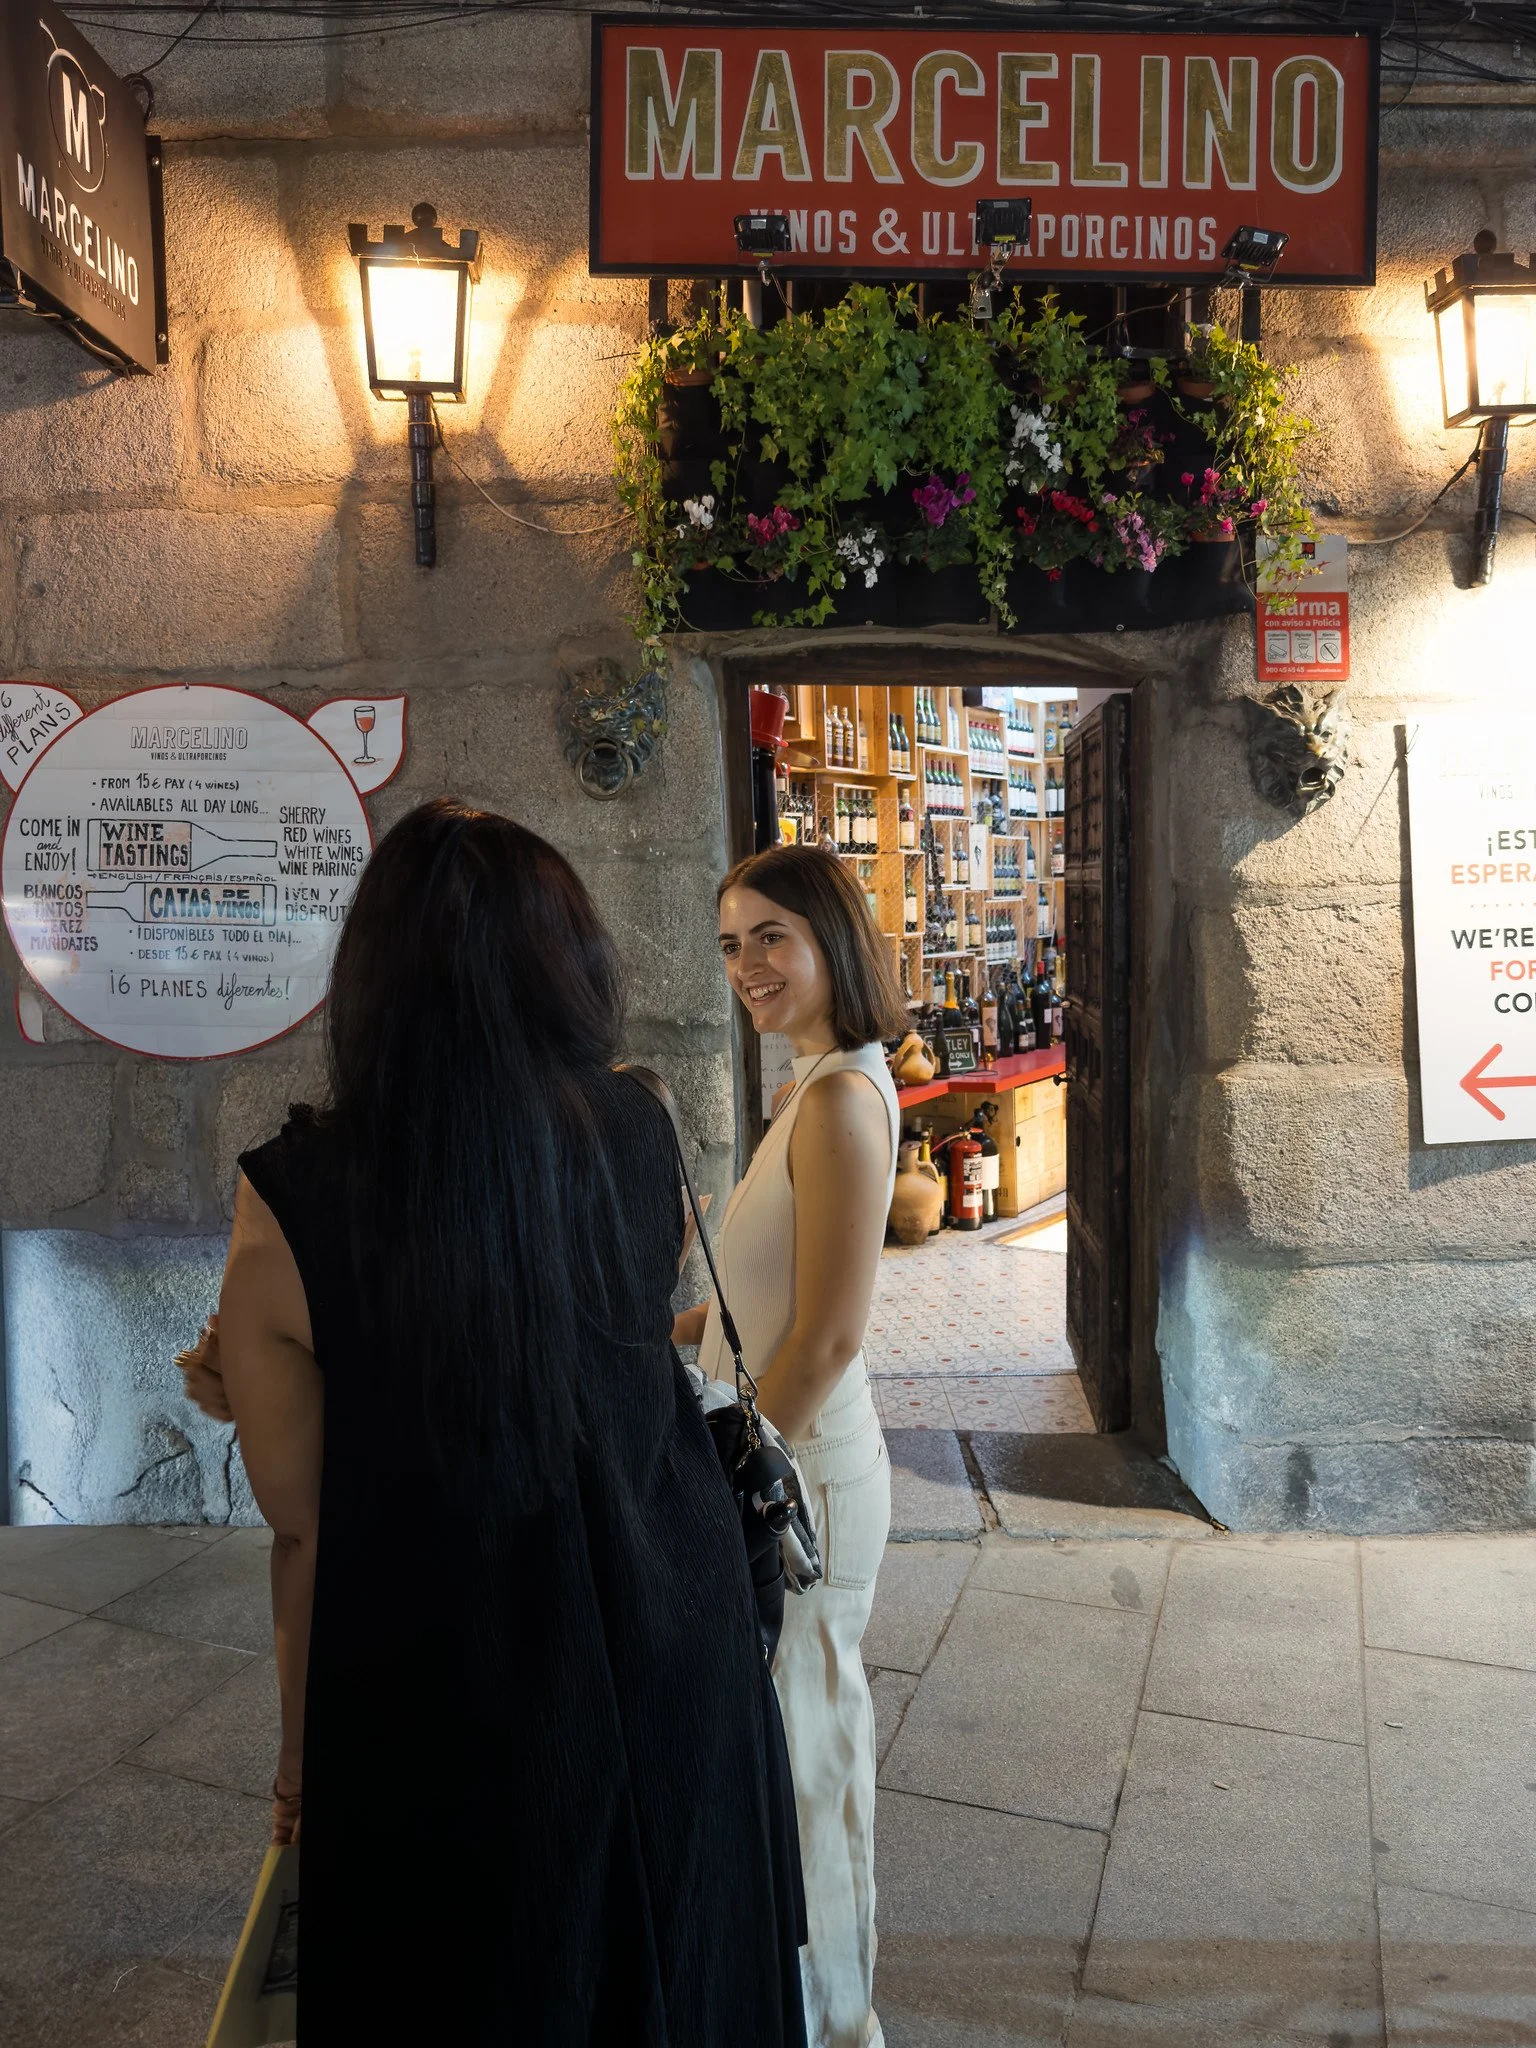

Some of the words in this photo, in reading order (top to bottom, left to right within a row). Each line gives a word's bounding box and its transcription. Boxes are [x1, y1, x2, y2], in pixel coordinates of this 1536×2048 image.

[62, 71, 91, 173] M
[625, 45, 1344, 194] MARCELINO
[17, 152, 139, 306] MARCELINO
[749, 208, 857, 254] NOS
[871, 207, 910, 255] &
[922, 211, 1217, 261] ULTPORCINOS
[1264, 599, 1341, 617] arma
[1281, 618, 1303, 627] aviso
[6, 702, 71, 766] PLANS
[130, 726, 249, 750] MARCELINO
[150, 752, 169, 761] VINOS
[178, 752, 227, 761] ULTRAPORCINOS
[101, 777, 130, 789] FROM
[164, 777, 185, 789] PAX
[100, 795, 174, 812] AVAILABLES
[180, 799, 199, 812] ALL
[204, 799, 228, 814] DAY
[279, 805, 327, 825] SHERRY
[19, 818, 63, 837] COME
[67, 815, 81, 837] IN
[102, 822, 165, 842] WINE
[284, 826, 307, 843] RED
[313, 826, 352, 844] WINES
[36, 837, 62, 851] and
[284, 843, 323, 861] WHITE
[326, 844, 365, 863] WINES
[25, 848, 77, 875] ENJOY!
[102, 843, 190, 867] TASTINGS
[98, 872, 153, 881] ENGLISH
[278, 860, 308, 876] WINE
[312, 860, 357, 877] PAIRING
[1451, 863, 1536, 884] ESPER
[23, 884, 84, 899] BLANCOS
[329, 888, 340, 903] Y
[33, 899, 84, 918] TINTOS
[150, 887, 212, 919] CATAS
[222, 888, 250, 899] DE
[215, 900, 261, 920] VINOS
[30, 935, 99, 951] MARIDAJES
[137, 925, 215, 942] ¡DISPONIBLES
[222, 929, 250, 943] TODO
[253, 931, 264, 943] EL
[1450, 927, 1534, 949] WE'RE
[138, 949, 171, 961] DESDE
[203, 950, 222, 961] PAX
[140, 977, 207, 998] PLANES
[216, 972, 291, 1011] diferentes!
[1494, 992, 1536, 1014] CO
